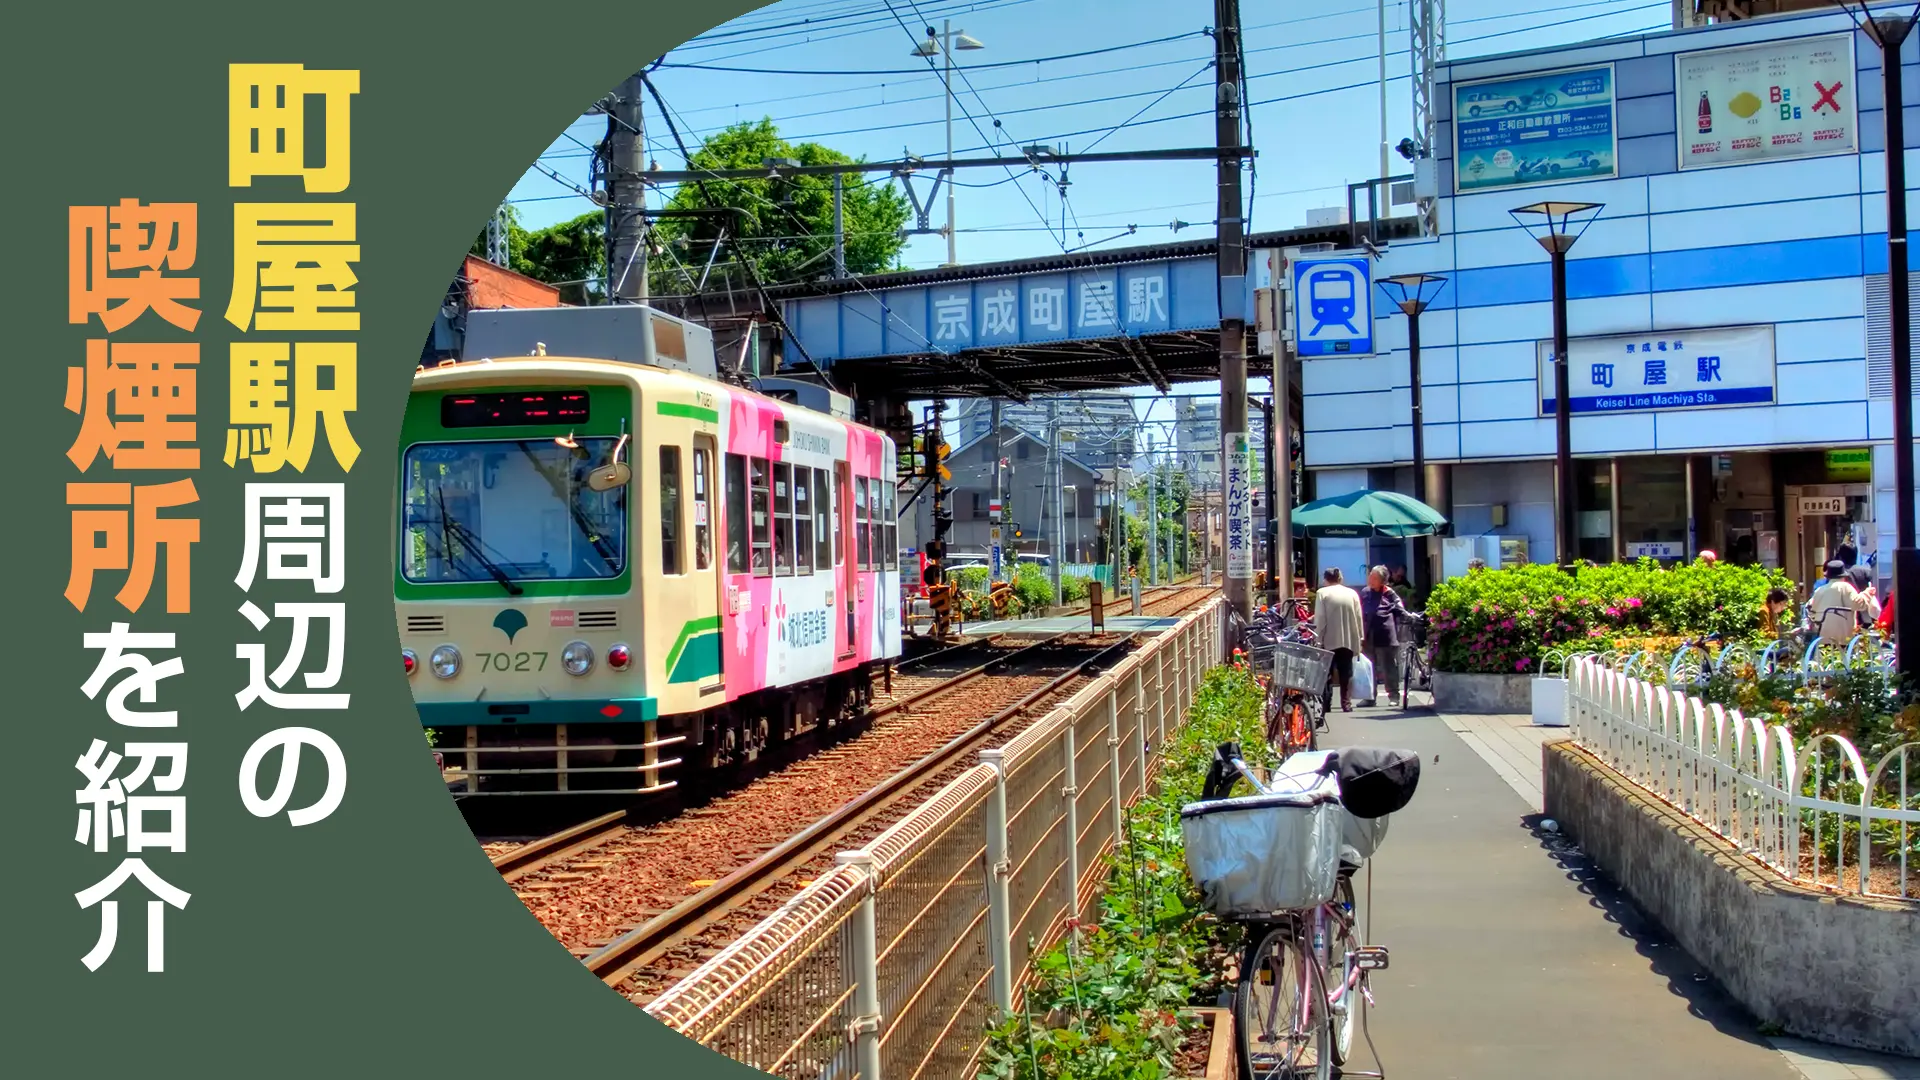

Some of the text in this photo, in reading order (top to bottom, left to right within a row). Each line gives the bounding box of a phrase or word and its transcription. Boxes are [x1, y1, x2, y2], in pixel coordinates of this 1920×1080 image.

[934, 275, 1167, 342] 京成町屋駅
[1626, 340, 1684, 354] 京成電鉄
[1591, 356, 1722, 389] 町屋駅
[1596, 392, 1718, 408] Keisei Line Machiya Sta.
[1228, 466, 1242, 551] まんが喫茶
[476, 651, 549, 673] 7027
